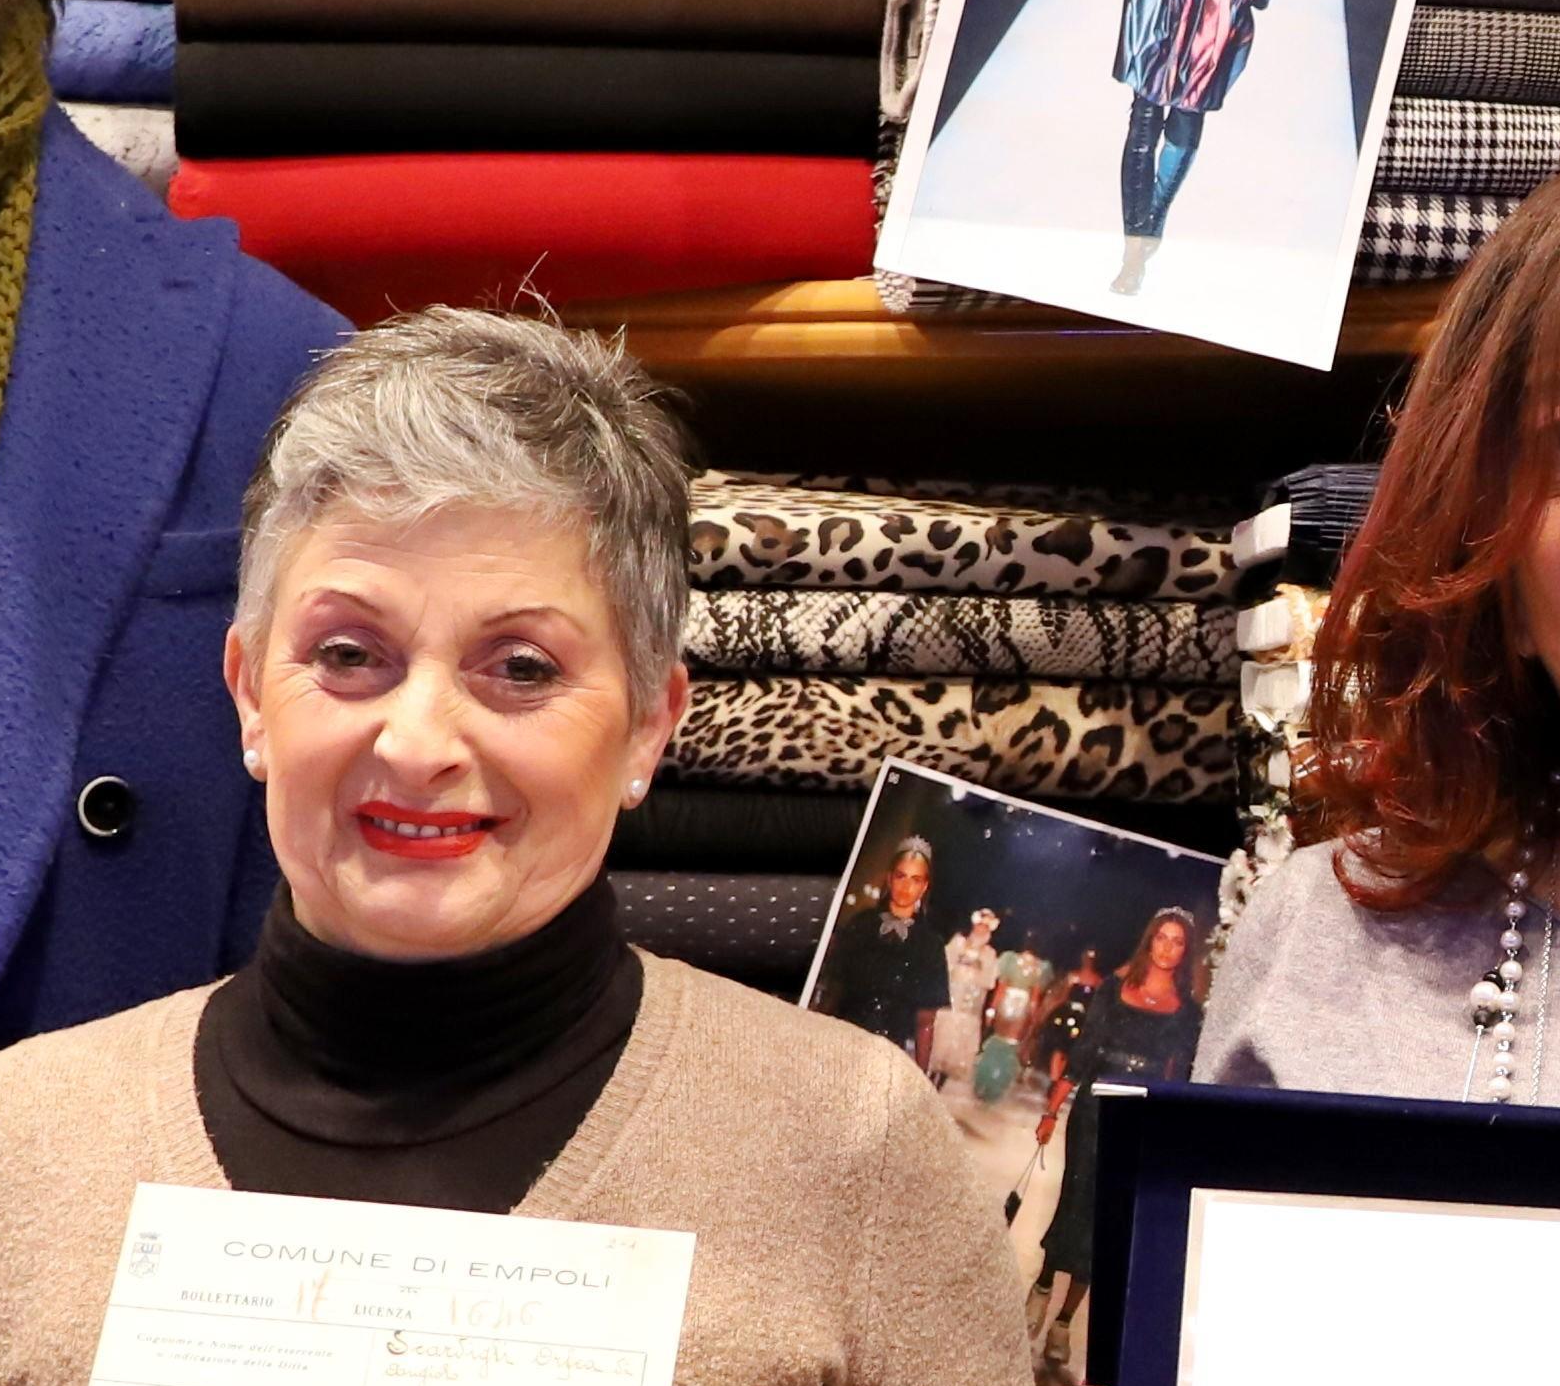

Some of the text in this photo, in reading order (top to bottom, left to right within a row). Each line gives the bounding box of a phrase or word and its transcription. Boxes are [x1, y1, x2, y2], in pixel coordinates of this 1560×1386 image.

[223, 1240, 611, 1290] COMUNE DI EMPOLI
[353, 1303, 413, 1320] LICENZA
[136, 1332, 193, 1346] Cognome
[209, 1340, 244, 1350] Nome
[169, 1351, 237, 1365] indicazione
